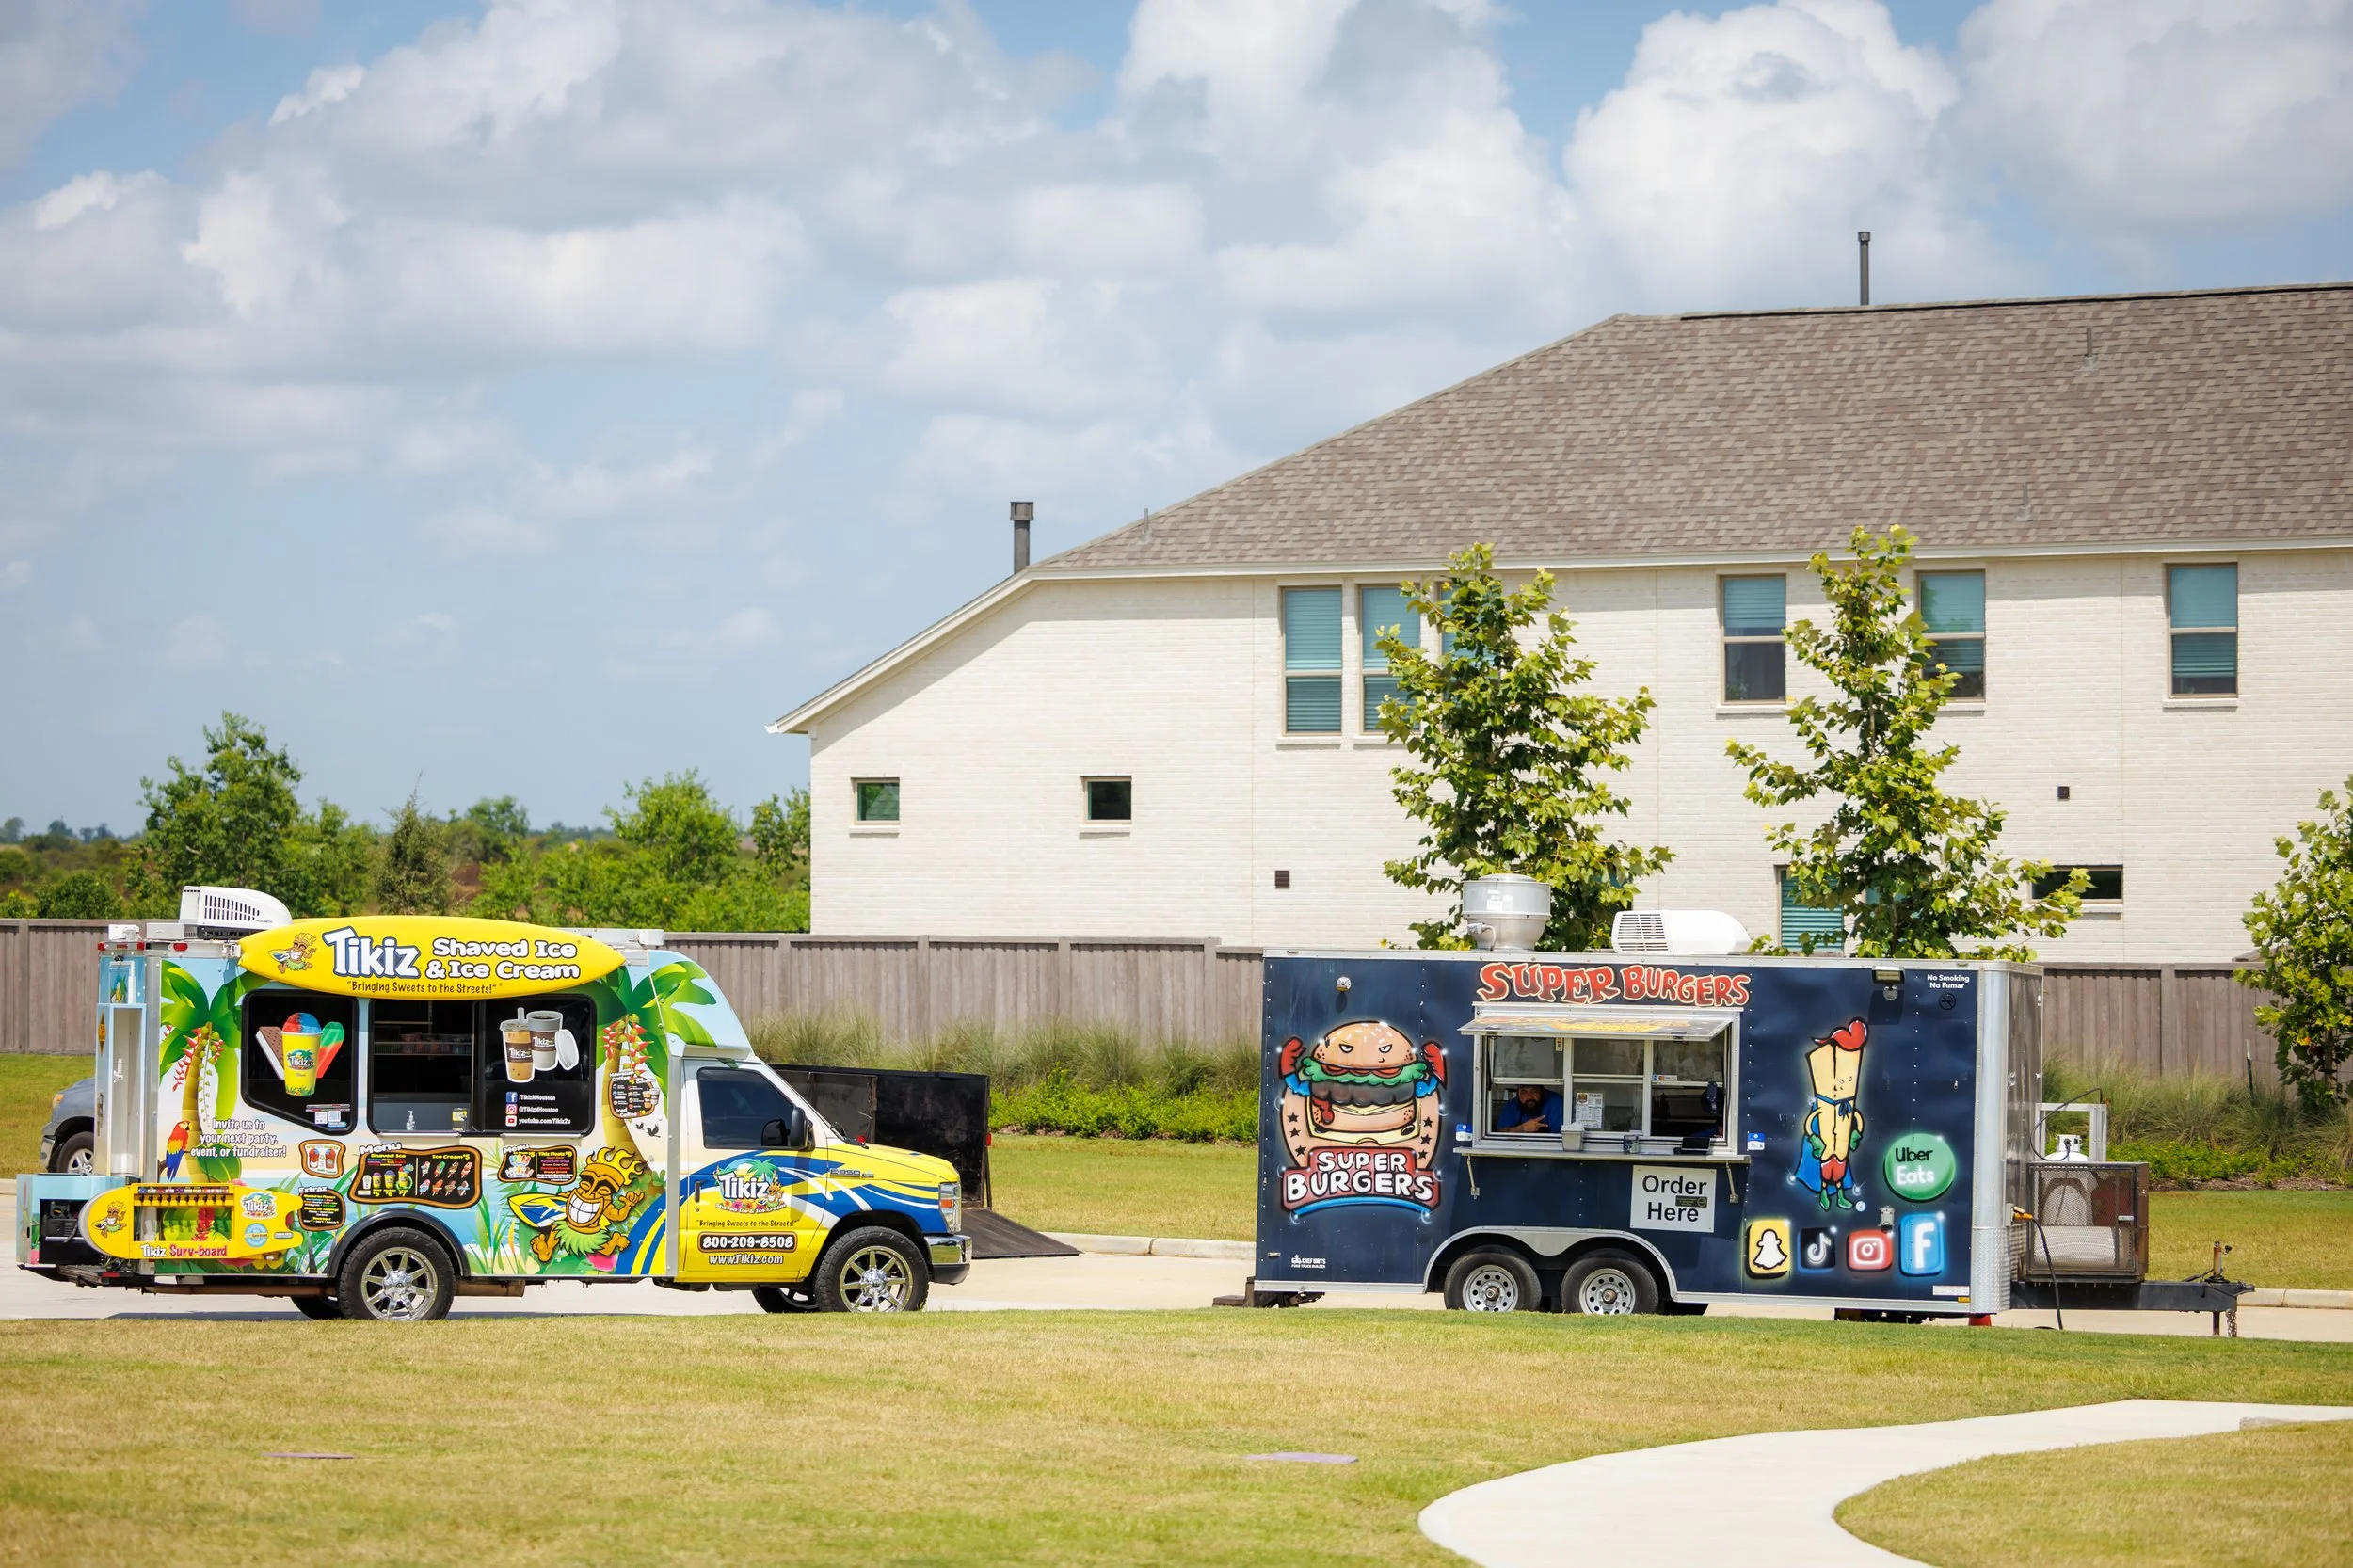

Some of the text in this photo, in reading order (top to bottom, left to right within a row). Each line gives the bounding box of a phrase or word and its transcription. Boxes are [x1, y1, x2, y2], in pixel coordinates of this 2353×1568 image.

[322, 926, 421, 979] Tikiz
[432, 937, 578, 958] Shaved Ice
[425, 959, 582, 980] & Ice Cream
[1476, 962, 1752, 1007] SUPER BURGERS
[1939, 974, 1970, 983] Smoking
[392, 982, 424, 994] Sweets
[427, 984, 437, 993] to
[440, 983, 455, 994] the
[212, 1118, 265, 1129] Invite us to
[200, 1133, 223, 1145] your
[224, 1133, 248, 1144] next
[190, 1146, 287, 1158] event, or fundraiser!
[360, 1142, 403, 1155] Menu
[1896, 1147, 1934, 1162] Uber
[1318, 1151, 1406, 1173] SUPER
[1896, 1165, 1935, 1185] Eats
[718, 1170, 770, 1200] Tikiz
[1286, 1170, 1435, 1202] BURGERS
[1642, 1175, 1707, 1195] Order
[1647, 1201, 1699, 1222] Here
[727, 1219, 749, 1227] Sweets
[758, 1219, 769, 1227] the
[140, 1243, 228, 1257] Tikiz Surv-board
[702, 1236, 794, 1249] 800-209-8508
